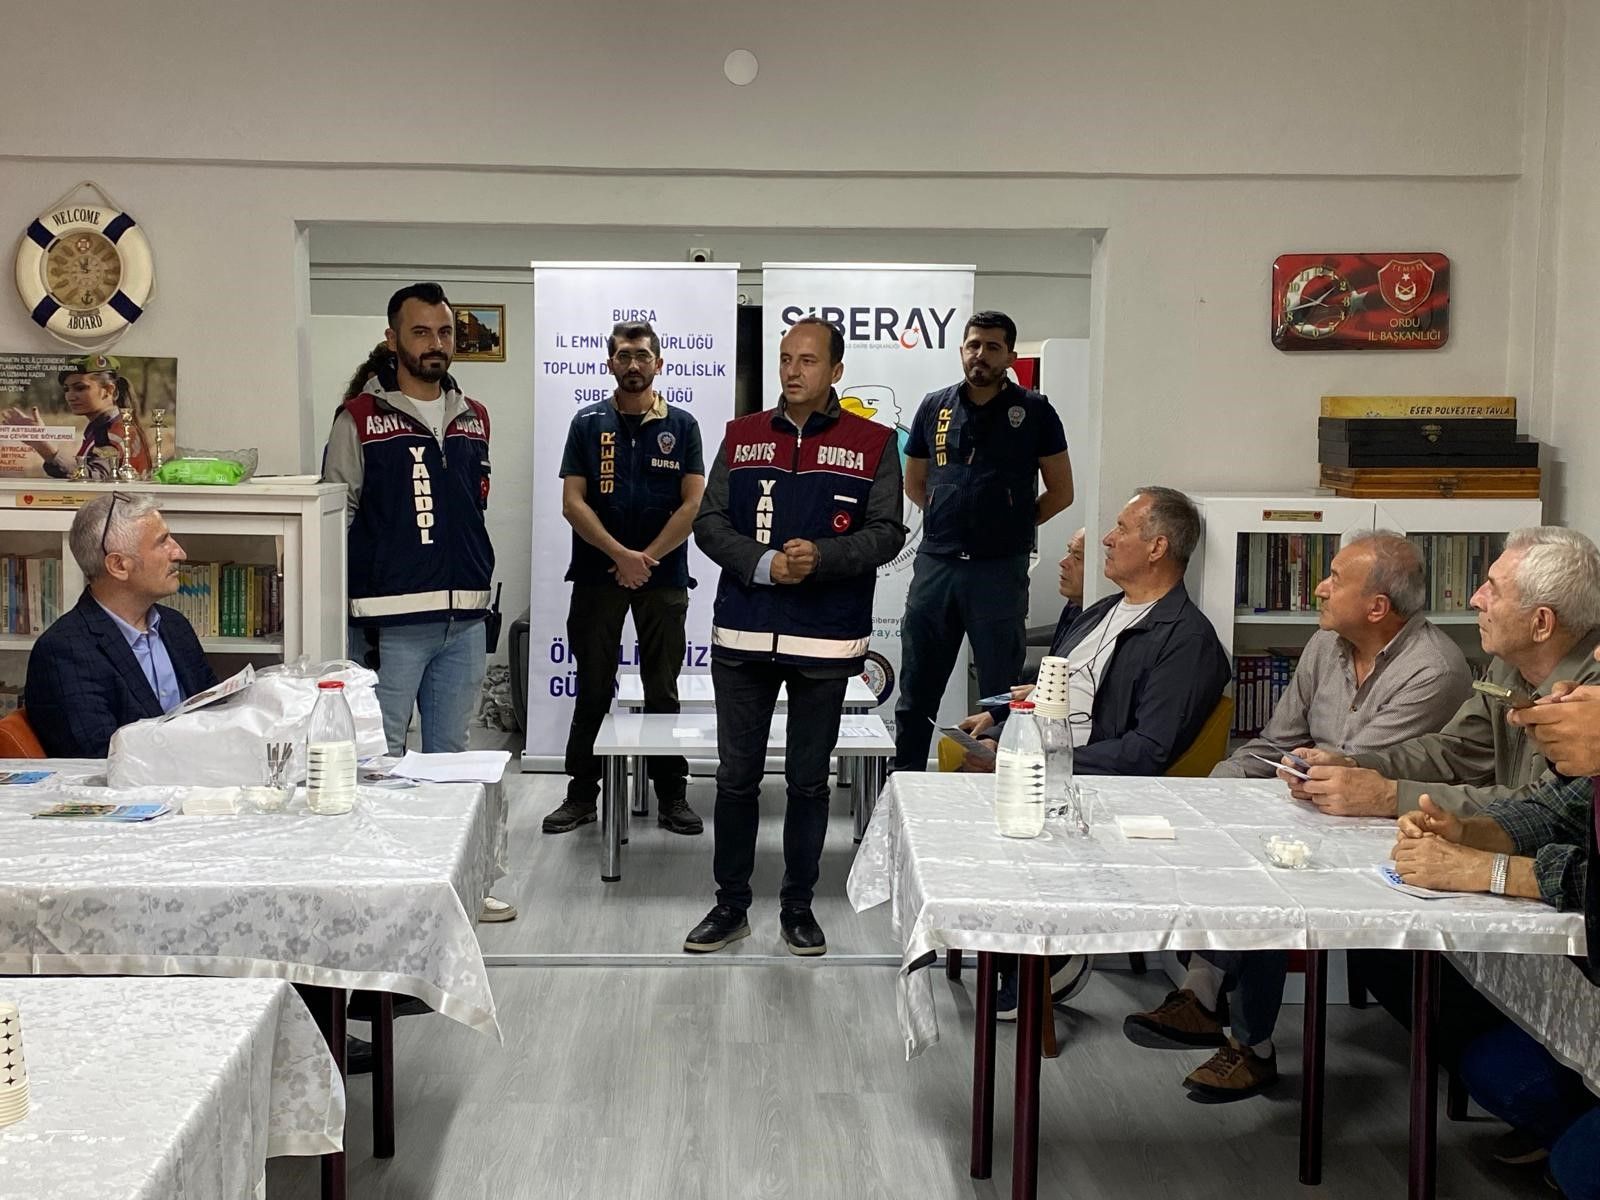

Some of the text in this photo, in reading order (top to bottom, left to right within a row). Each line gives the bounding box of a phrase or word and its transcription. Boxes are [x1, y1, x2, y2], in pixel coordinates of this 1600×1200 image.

[52, 209, 100, 226] WELCOME
[67, 315, 103, 330] ABOARD
[613, 310, 657, 322] BURSA
[1390, 318, 1420, 328] ORDU
[556, 332, 568, 348] İL
[571, 333, 609, 348] EMNİY
[1380, 329, 1440, 343] BAŞKANLIĞI
[543, 361, 596, 375] TOPLUM
[666, 361, 726, 377] POLİSLİK
[575, 389, 609, 404] ŞUBE
[1410, 406, 1510, 415] ESER POLYESTER TAVLA
[733, 442, 864, 470] ASAYİŞ BURSA
[651, 458, 680, 470] BURSA
[408, 446, 434, 545] YANDOL
[756, 480, 776, 545] YAND
